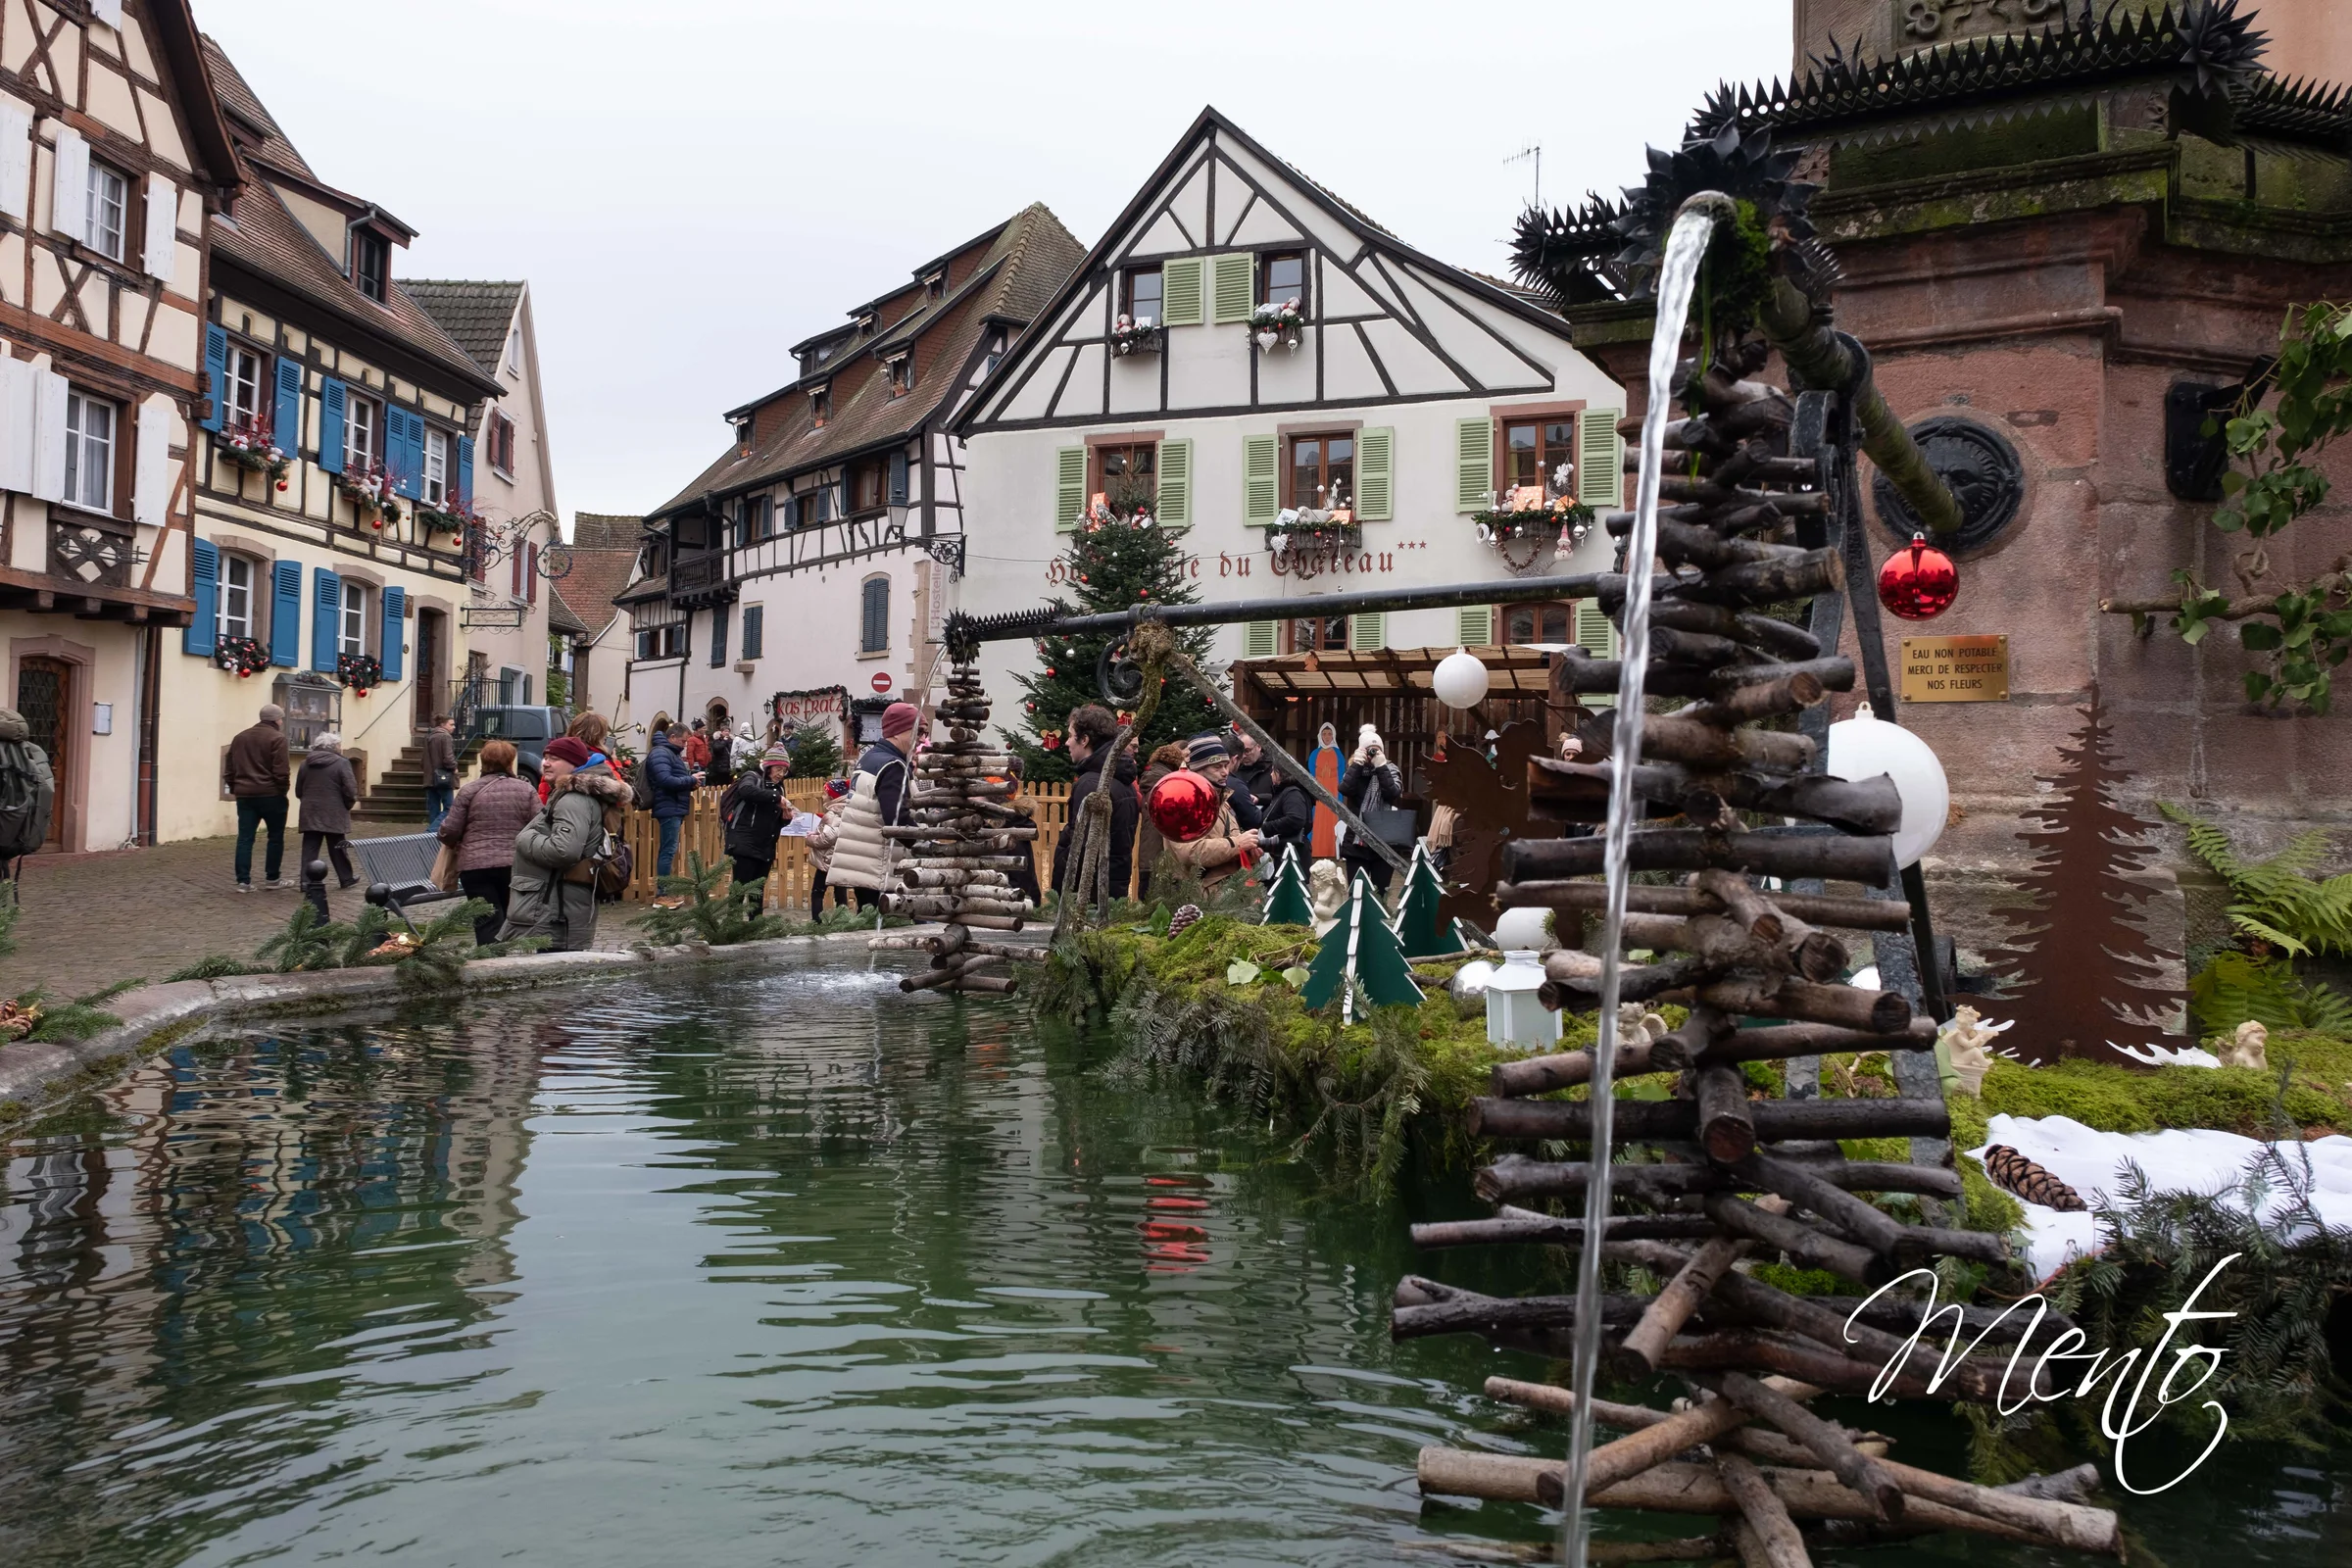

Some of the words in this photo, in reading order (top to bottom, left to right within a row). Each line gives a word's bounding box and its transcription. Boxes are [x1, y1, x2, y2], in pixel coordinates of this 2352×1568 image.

[1219, 551, 1250, 577] du
[1912, 649, 1930, 660] EAU
[1935, 648, 1954, 659] NON
[1959, 647, 1997, 658] POTABLE
[1907, 664, 1934, 675] MERCI
[1937, 663, 1950, 674] DE
[1954, 662, 2003, 673] RESPECTER
[1927, 679, 1945, 690] NOS
[1949, 678, 1983, 690] FLEURS
